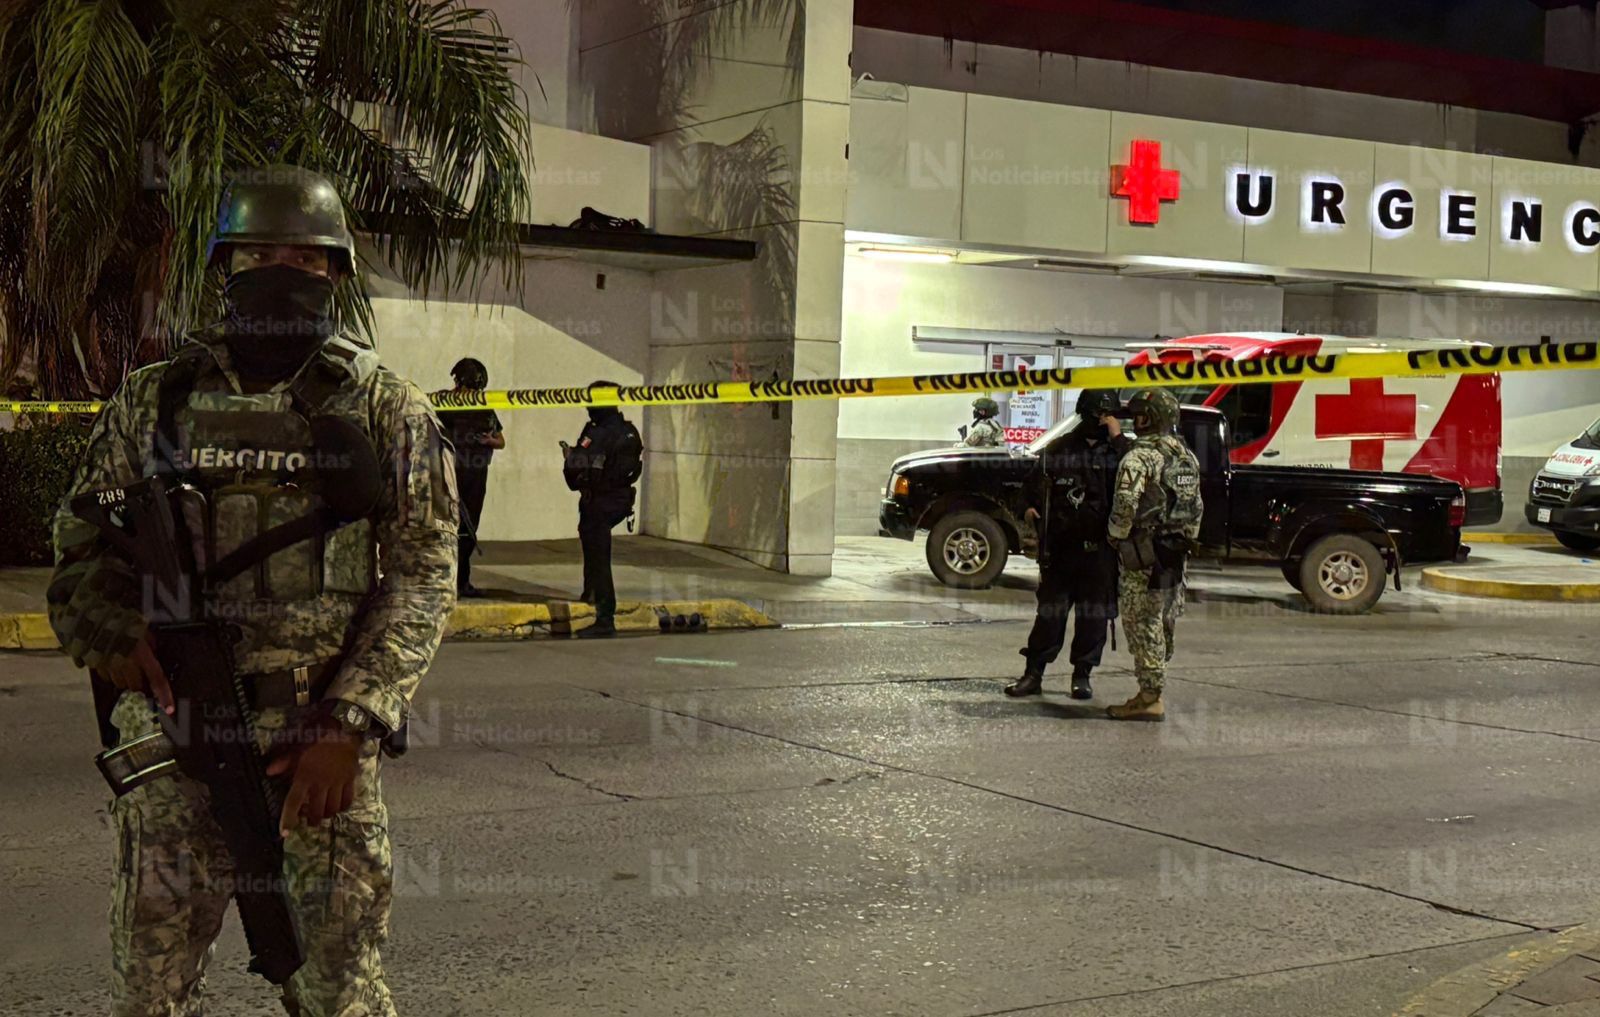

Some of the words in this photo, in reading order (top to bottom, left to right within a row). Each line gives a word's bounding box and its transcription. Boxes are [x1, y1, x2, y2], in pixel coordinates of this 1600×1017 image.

[1236, 173, 1600, 247] URGENC
[1124, 354, 1336, 382] PROHIBIDO
[750, 378, 873, 398] PROHIBIDO
[913, 368, 1072, 391] PROHIBIDO
[427, 390, 487, 407] OHIBIDO
[507, 388, 592, 405] PROHIBIDO
[617, 382, 718, 402] PROHIBIDO
[173, 444, 306, 473] EJÉRCITO
